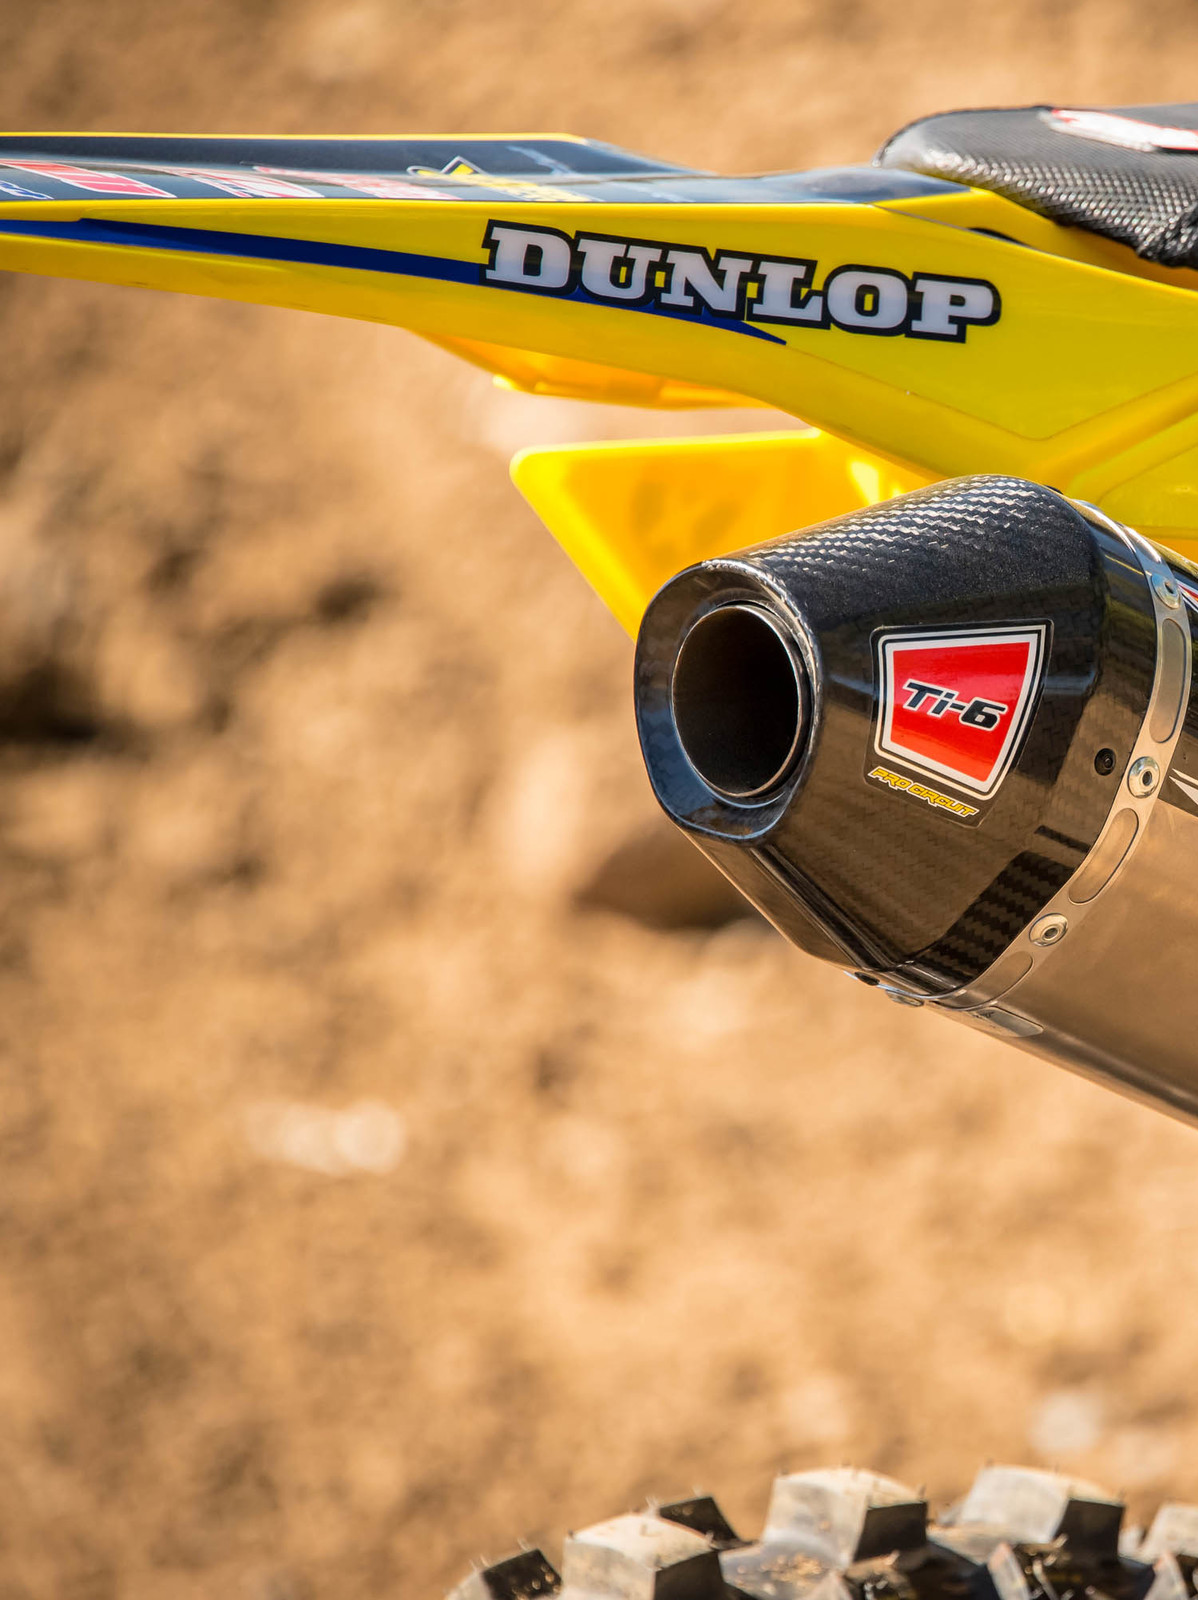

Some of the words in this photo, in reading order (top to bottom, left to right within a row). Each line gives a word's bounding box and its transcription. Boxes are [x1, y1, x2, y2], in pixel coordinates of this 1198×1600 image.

[483, 223, 997, 338] DUNLOP
[903, 680, 1007, 730] Ti-6
[871, 767, 912, 789] PRO
[907, 783, 977, 816] CIRCUIT
